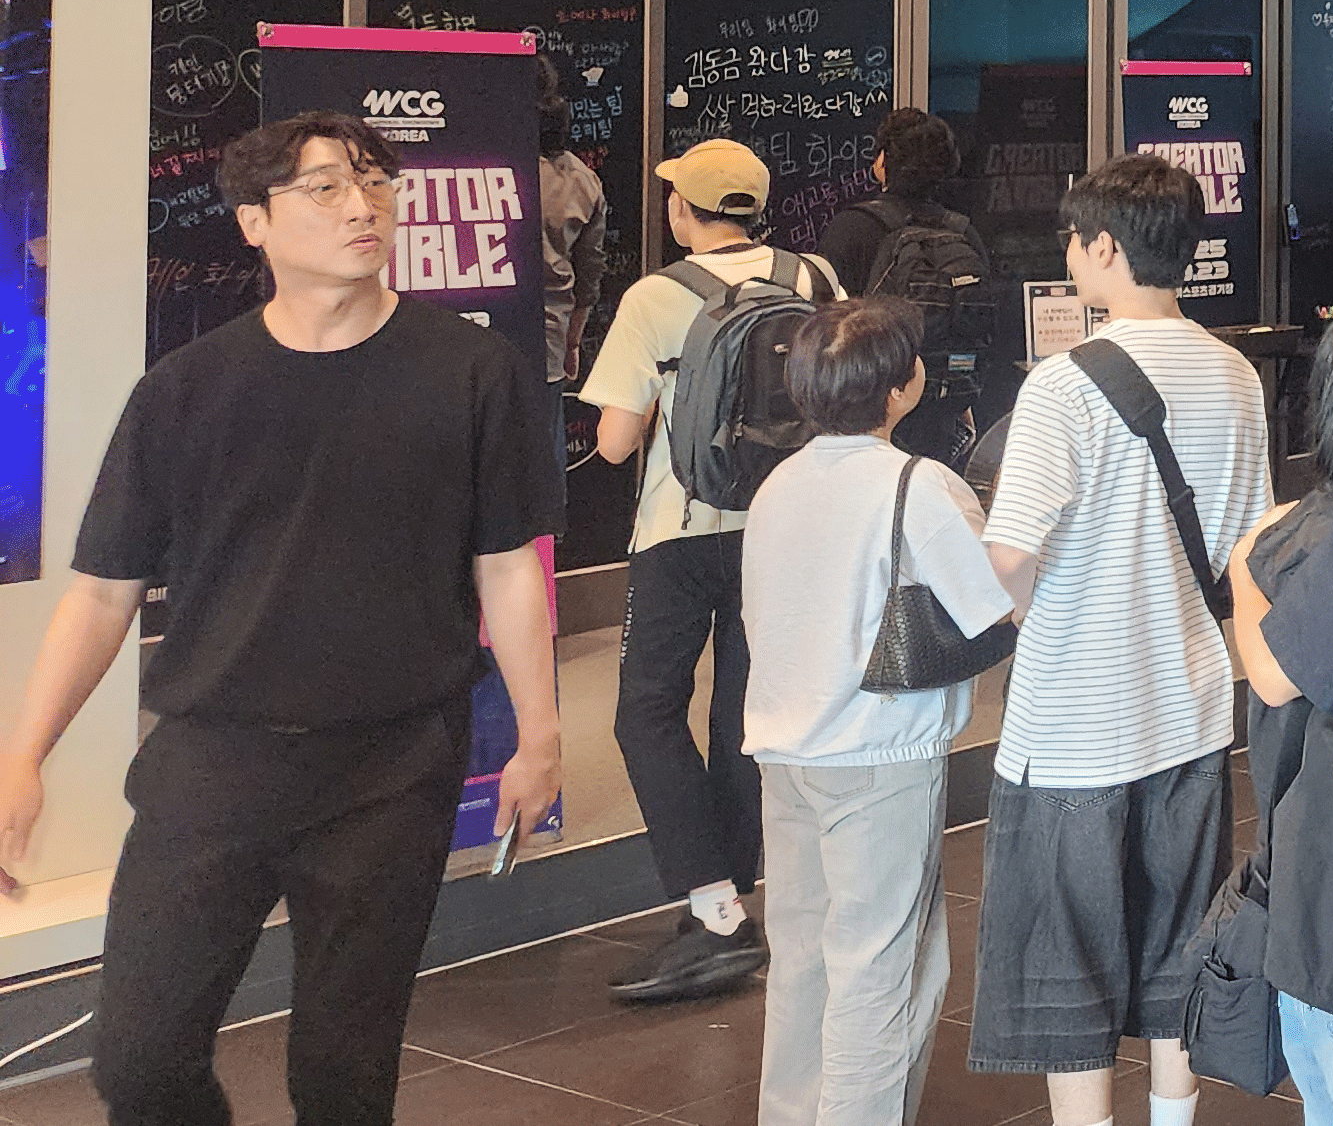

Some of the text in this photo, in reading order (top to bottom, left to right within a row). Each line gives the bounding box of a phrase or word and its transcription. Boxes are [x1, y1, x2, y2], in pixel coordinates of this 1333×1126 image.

[363, 89, 445, 116] WCG
[1169, 96, 1208, 113] WCG
[391, 167, 525, 223] ATOR
[1193, 239, 1228, 260] 25
